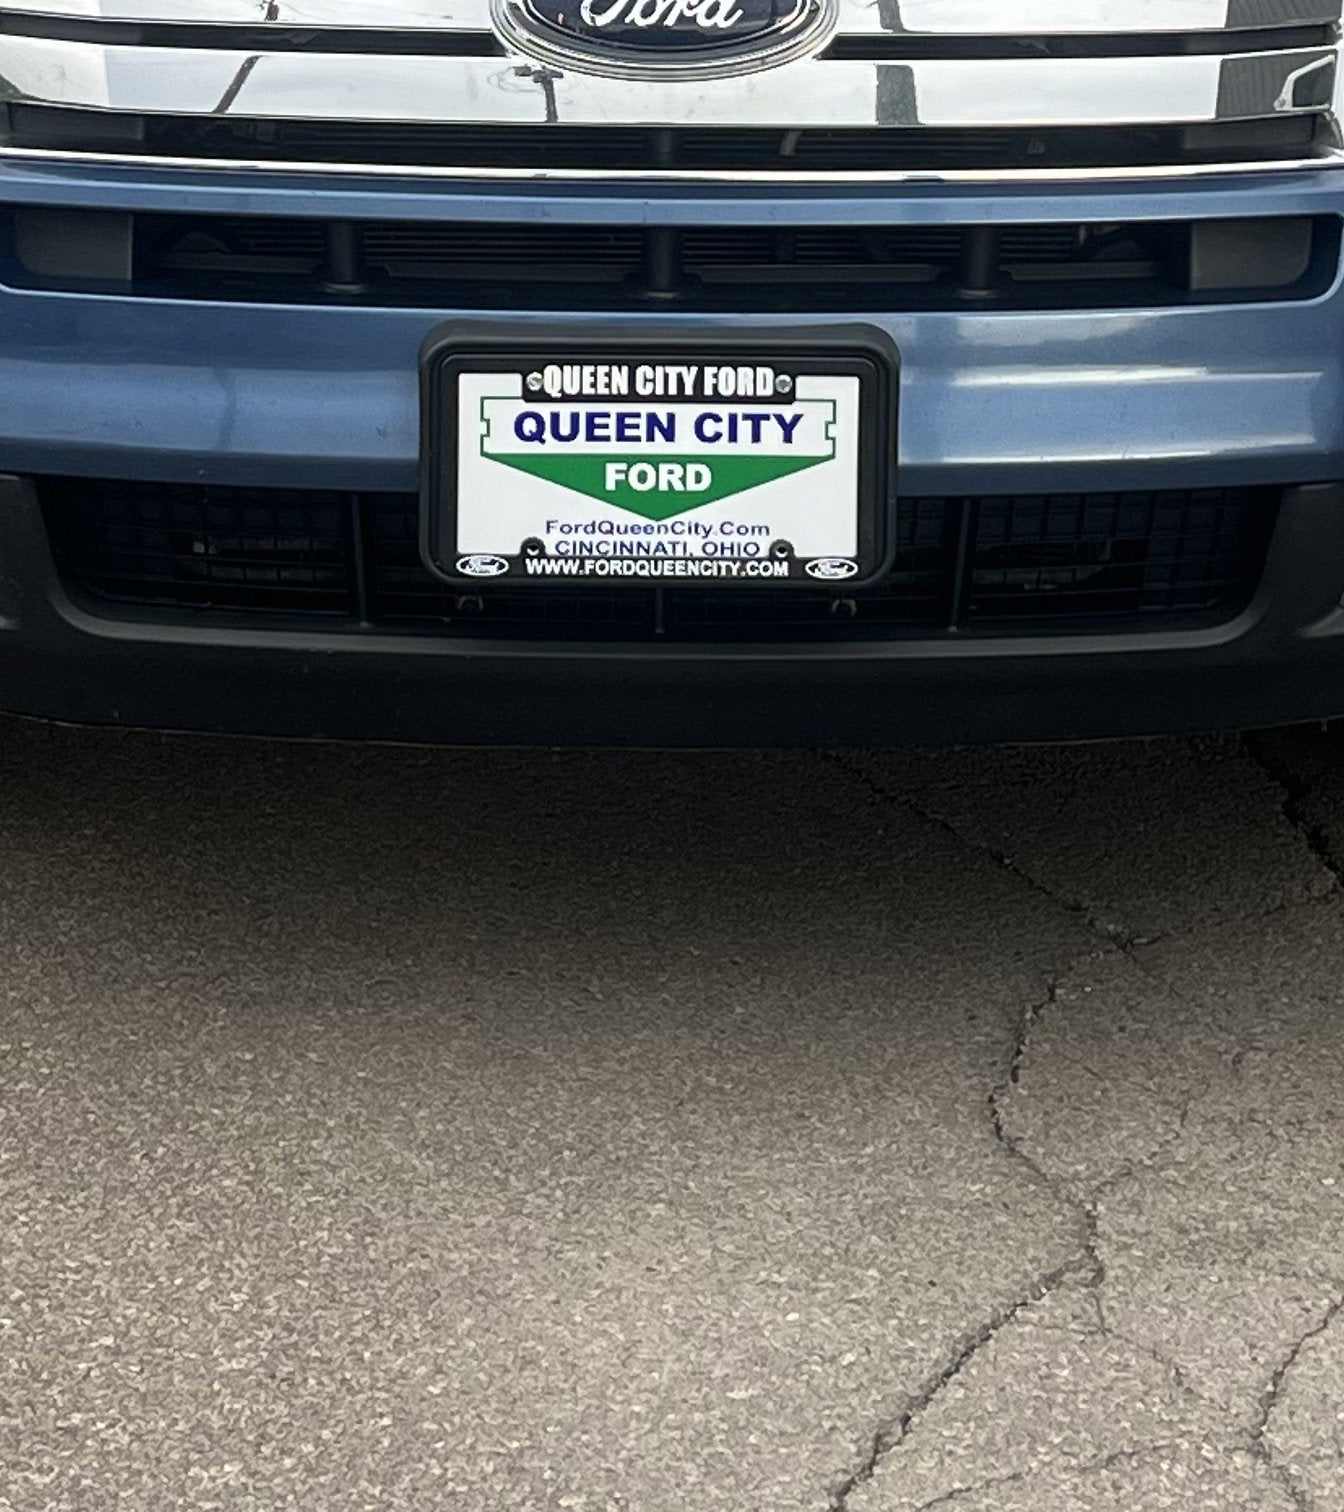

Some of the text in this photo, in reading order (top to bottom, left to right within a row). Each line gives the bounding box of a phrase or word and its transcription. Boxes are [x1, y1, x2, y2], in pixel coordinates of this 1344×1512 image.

[543, 364, 774, 398] QUEEN CITY FORD
[514, 411, 804, 445] QUEEN CITY
[605, 462, 712, 492] FORD
[545, 520, 771, 539] FordQueenCity.Com
[555, 539, 761, 557] CINCINNATI, OHIO
[524, 558, 790, 577] WWW.FORDQUEENCITY.COM
